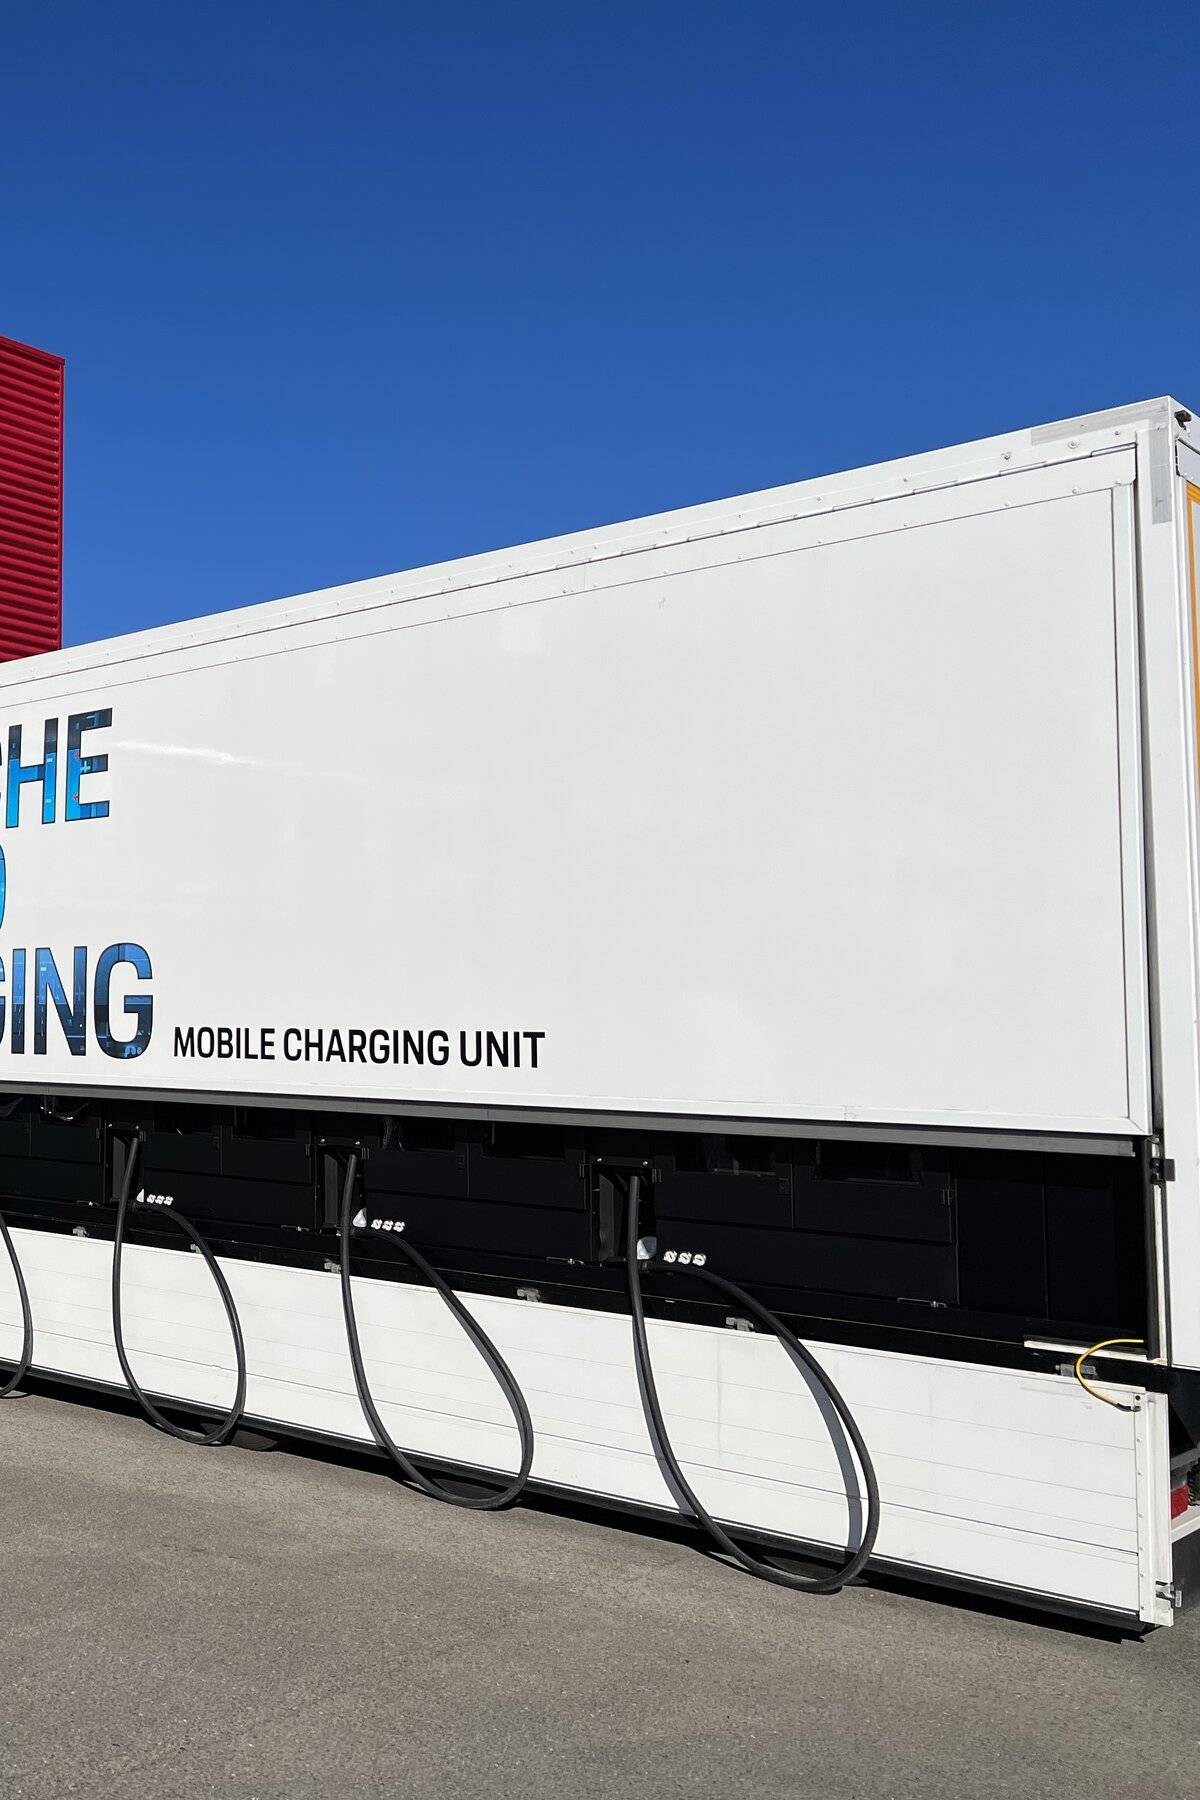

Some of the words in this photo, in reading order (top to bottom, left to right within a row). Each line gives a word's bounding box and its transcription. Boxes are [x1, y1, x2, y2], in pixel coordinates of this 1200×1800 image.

[173, 1026, 276, 1060] MOBILE
[283, 1028, 450, 1067] CHARGING
[459, 1031, 546, 1069] UNIT
